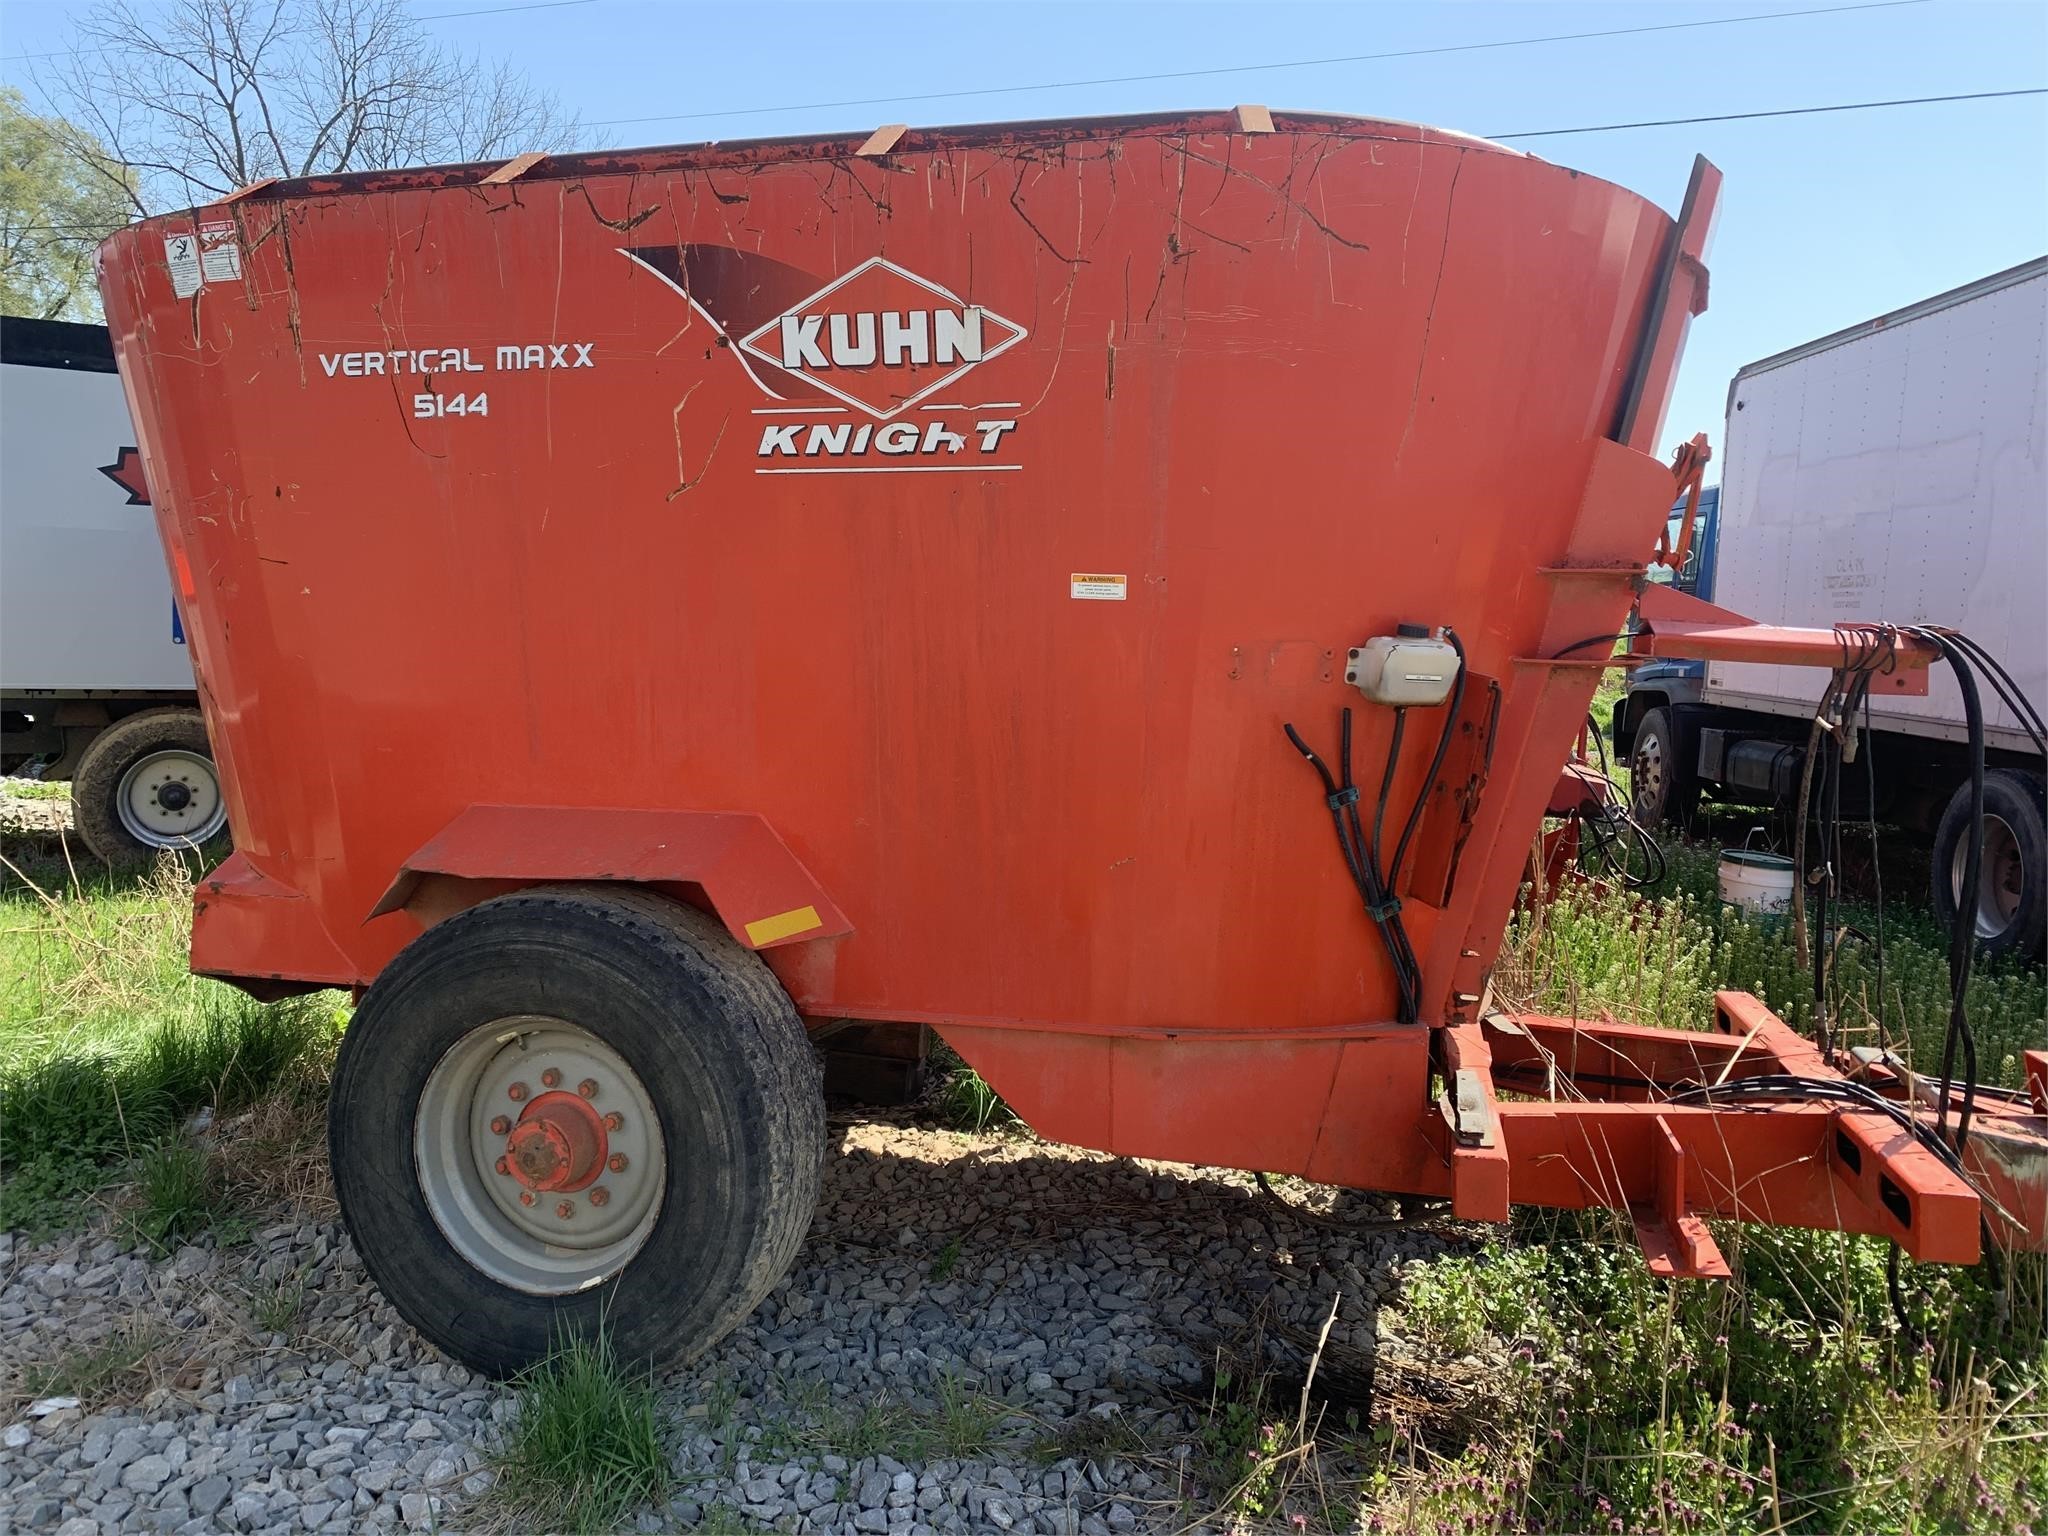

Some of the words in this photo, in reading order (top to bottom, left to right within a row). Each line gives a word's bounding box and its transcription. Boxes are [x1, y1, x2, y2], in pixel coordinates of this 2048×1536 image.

[781, 307, 984, 369] KUHN
[318, 347, 484, 378] VERTICAL
[496, 343, 595, 371] MAXX
[414, 392, 488, 418] 5144
[758, 420, 1017, 457] KNIGHT
